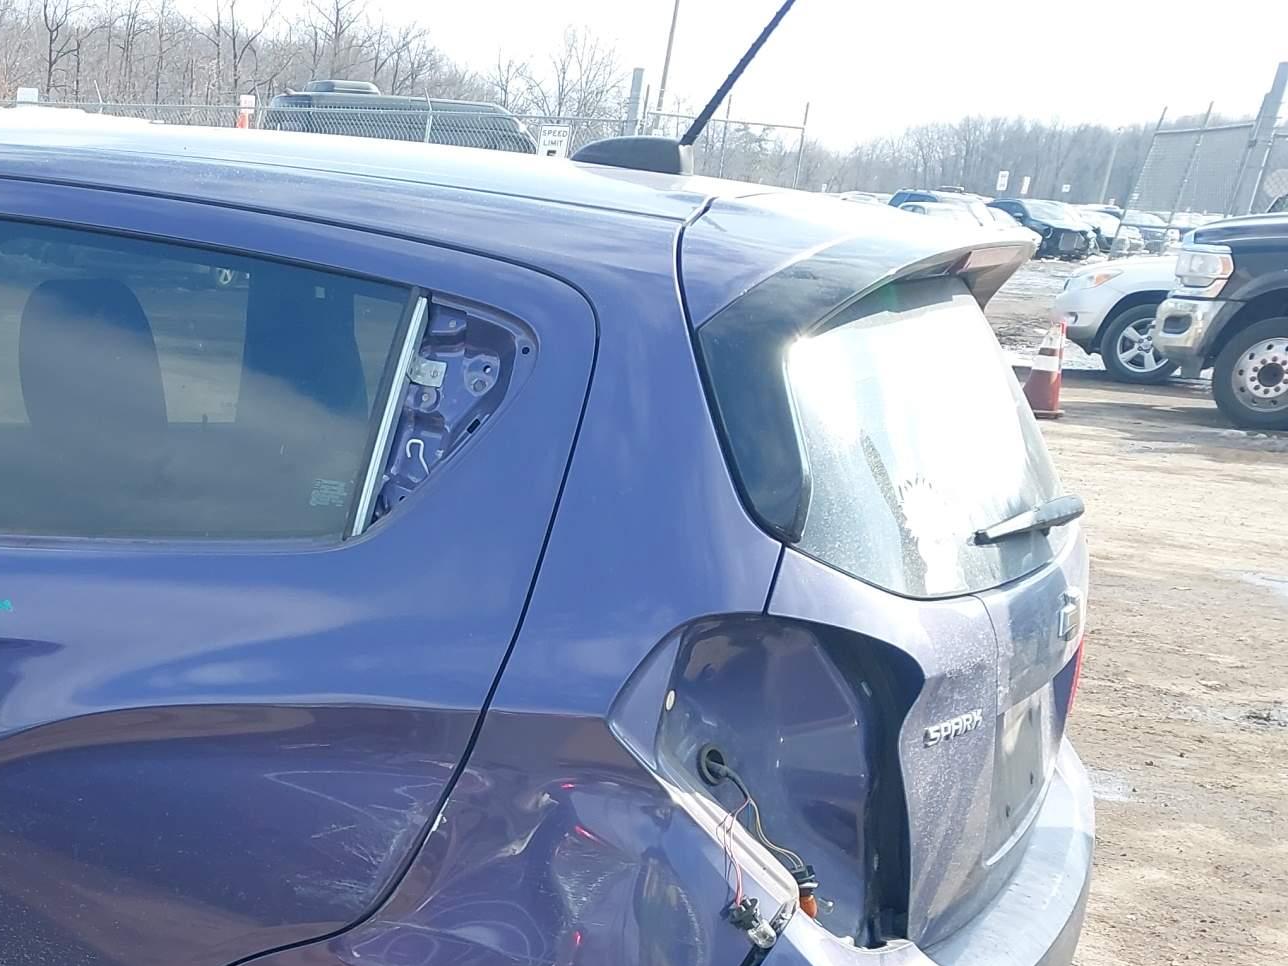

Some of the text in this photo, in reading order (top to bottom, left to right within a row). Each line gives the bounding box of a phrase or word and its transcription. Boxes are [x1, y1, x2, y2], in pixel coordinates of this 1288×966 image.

[542, 129, 568, 138] SPEED
[543, 138, 564, 148] LIMIT
[922, 707, 983, 748] SPARK
